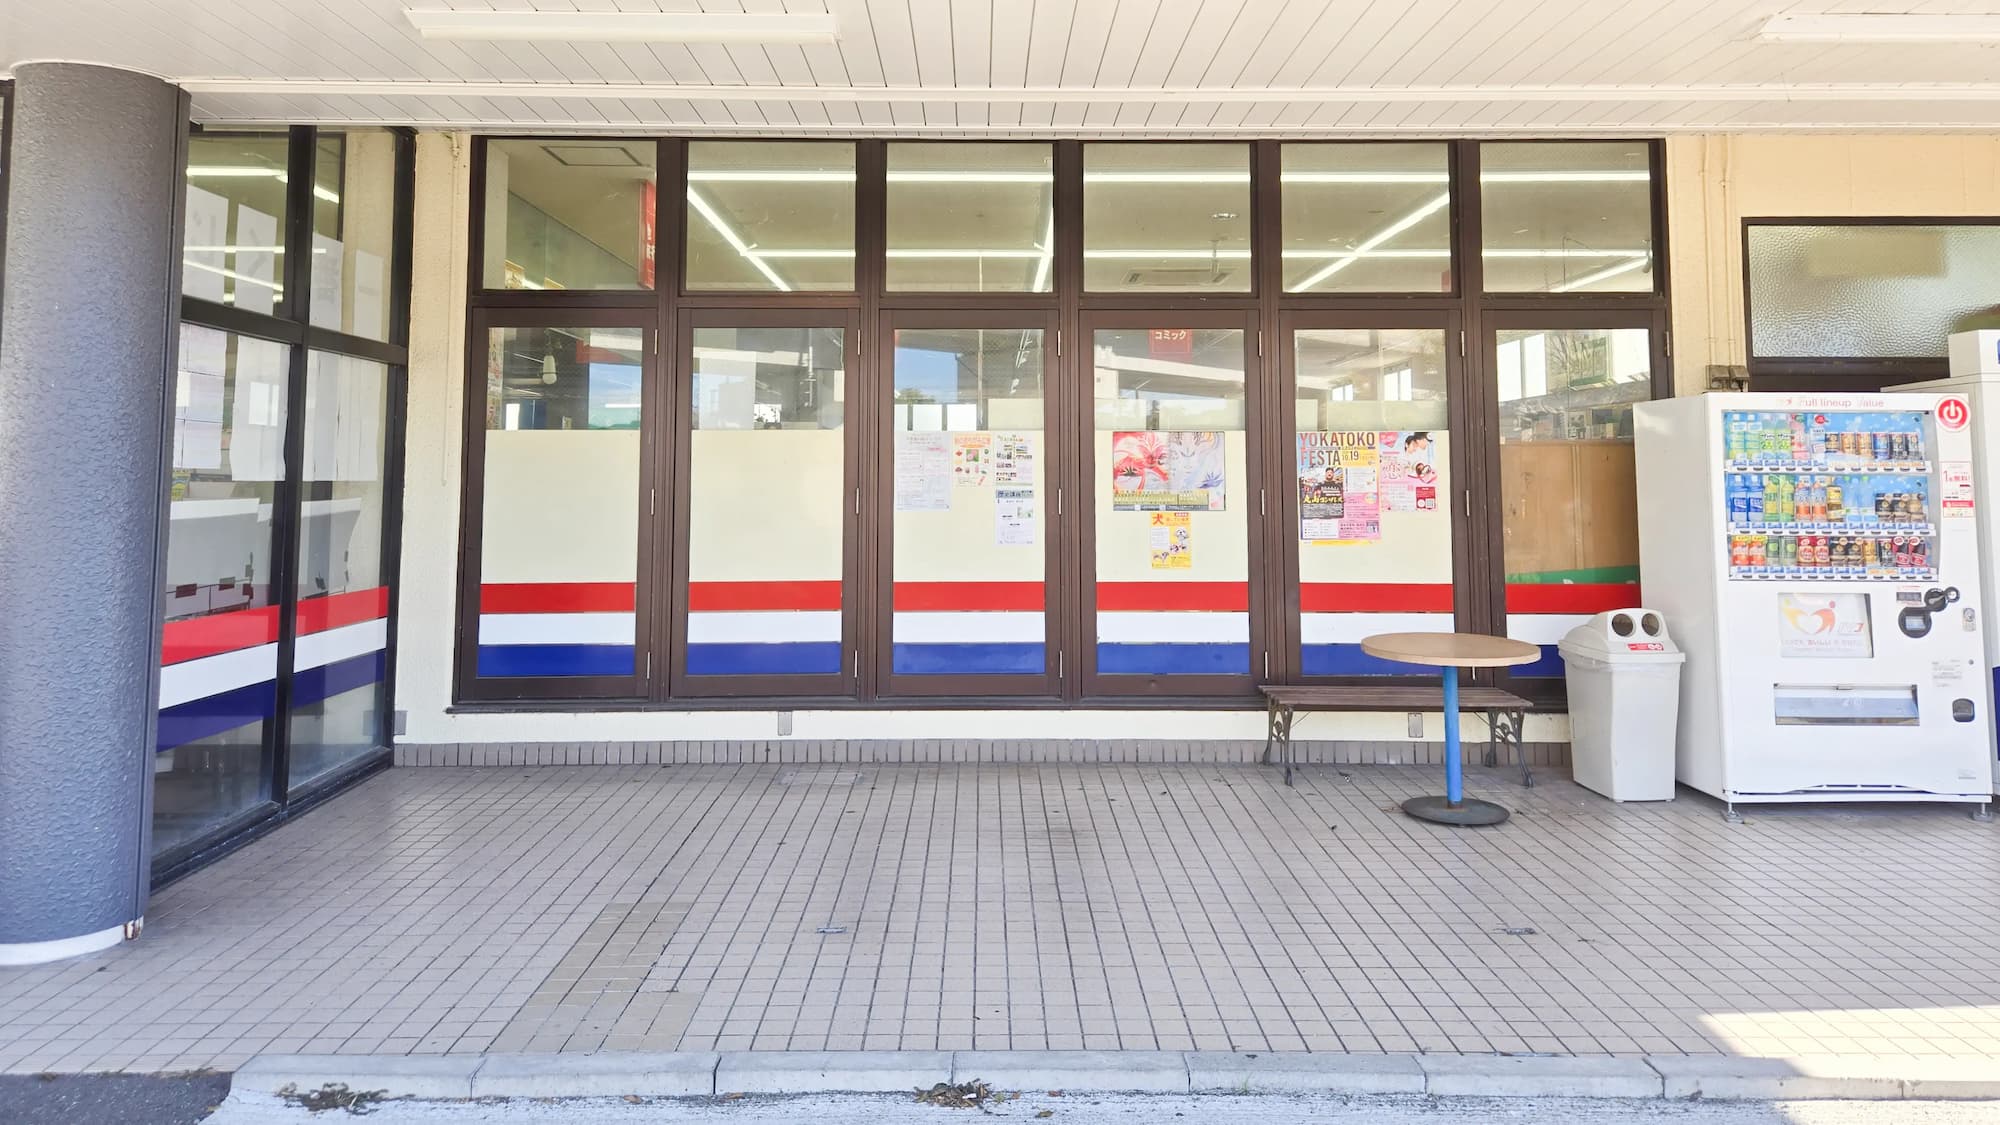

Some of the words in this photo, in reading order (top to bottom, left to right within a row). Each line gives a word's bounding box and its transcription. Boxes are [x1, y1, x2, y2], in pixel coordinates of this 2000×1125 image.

[1155, 330, 1187, 340] コミック
[1820, 399, 1852, 409] lineup
[1300, 432, 1375, 446] YOKATOKO
[1301, 448, 1341, 465] FESTA
[1152, 513, 1164, 525] 犬
